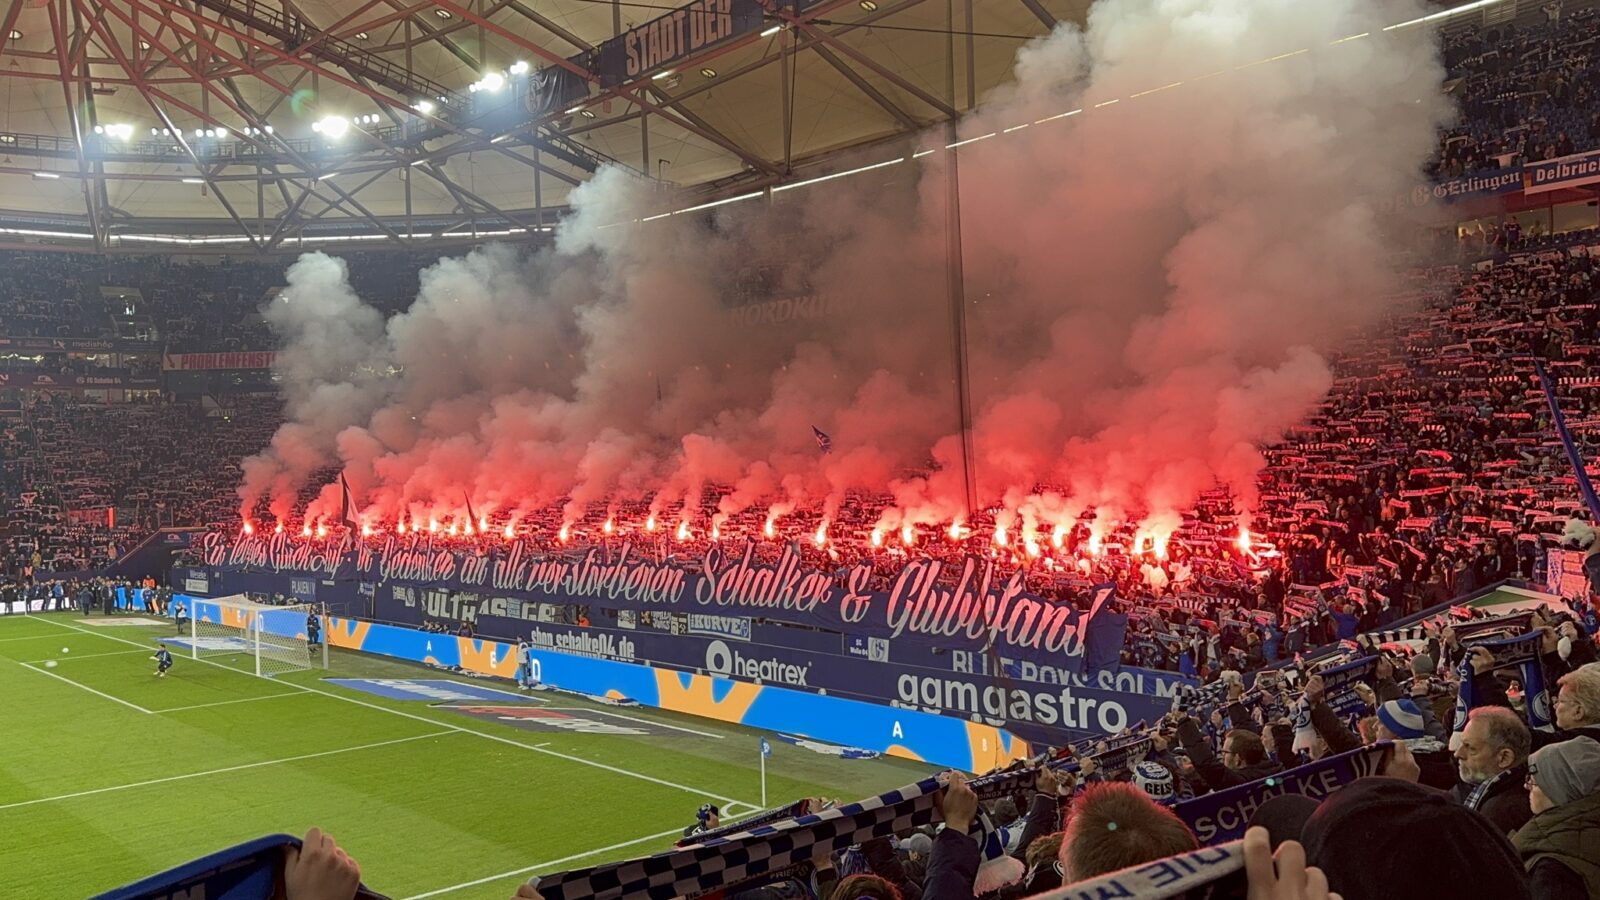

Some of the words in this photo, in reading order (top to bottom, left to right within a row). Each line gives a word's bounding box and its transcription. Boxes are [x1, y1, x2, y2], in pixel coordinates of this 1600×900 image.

[625, 13, 687, 76] STADT
[688, 0, 732, 49] DER
[180, 352, 277, 369] PROBLEMFENST
[379, 534, 456, 583] Gedenken
[460, 553, 488, 586] an
[492, 540, 528, 590] alle
[525, 541, 686, 604] verstorbenen
[695, 539, 833, 613] Schalker
[840, 563, 872, 623] &
[694, 614, 741, 635] KURVE
[532, 658, 541, 682] D
[735, 650, 809, 686] heatrex
[897, 673, 1128, 734] ggmgastro
[892, 721, 903, 739] A
